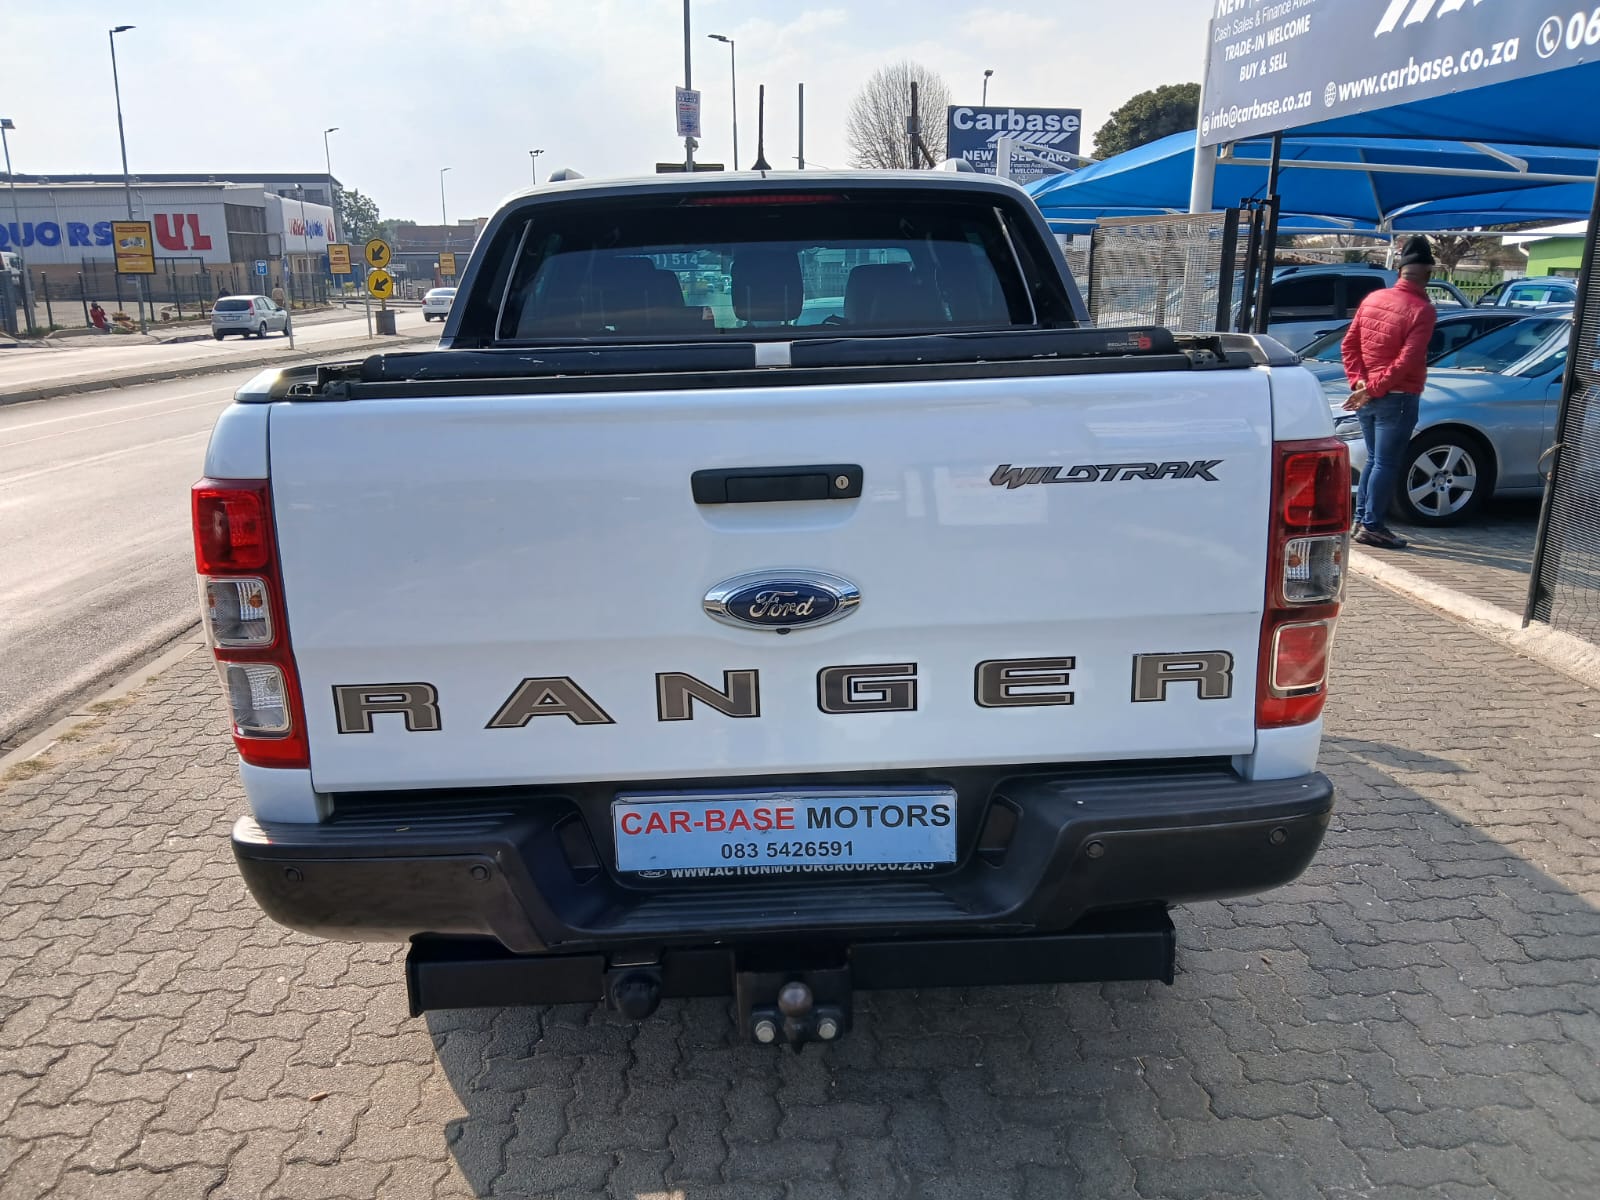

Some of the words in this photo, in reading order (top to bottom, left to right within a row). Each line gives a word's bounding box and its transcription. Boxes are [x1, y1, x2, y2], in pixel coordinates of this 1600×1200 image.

[1214, 23, 1232, 43] Cash
[1233, 16, 1254, 35] Sales
[1255, 10, 1262, 27] &
[1262, 1, 1292, 24] Finance
[1225, 33, 1266, 62] TRADE-IN
[1267, 14, 1311, 47] WELCOME
[1565, 7, 1600, 50] 06
[1239, 60, 1258, 82] BUY
[1259, 59, 1267, 75] &
[1269, 51, 1288, 73] SELL
[1338, 37, 1520, 101] www.carbase.co.za
[953, 108, 1079, 131] Carbase
[1211, 89, 1312, 130] info@carbase.co.za
[962, 150, 993, 160] NEW
[153, 213, 213, 250] UL
[671, 253, 698, 265] 514
[989, 459, 1225, 490] WILDTRAK
[749, 590, 815, 617] Ford
[331, 648, 1235, 735] RANGER
[620, 807, 796, 836] CAR-BASE
[806, 804, 951, 830] MOTORS
[720, 843, 759, 860] 083
[766, 840, 855, 859] 5426591
